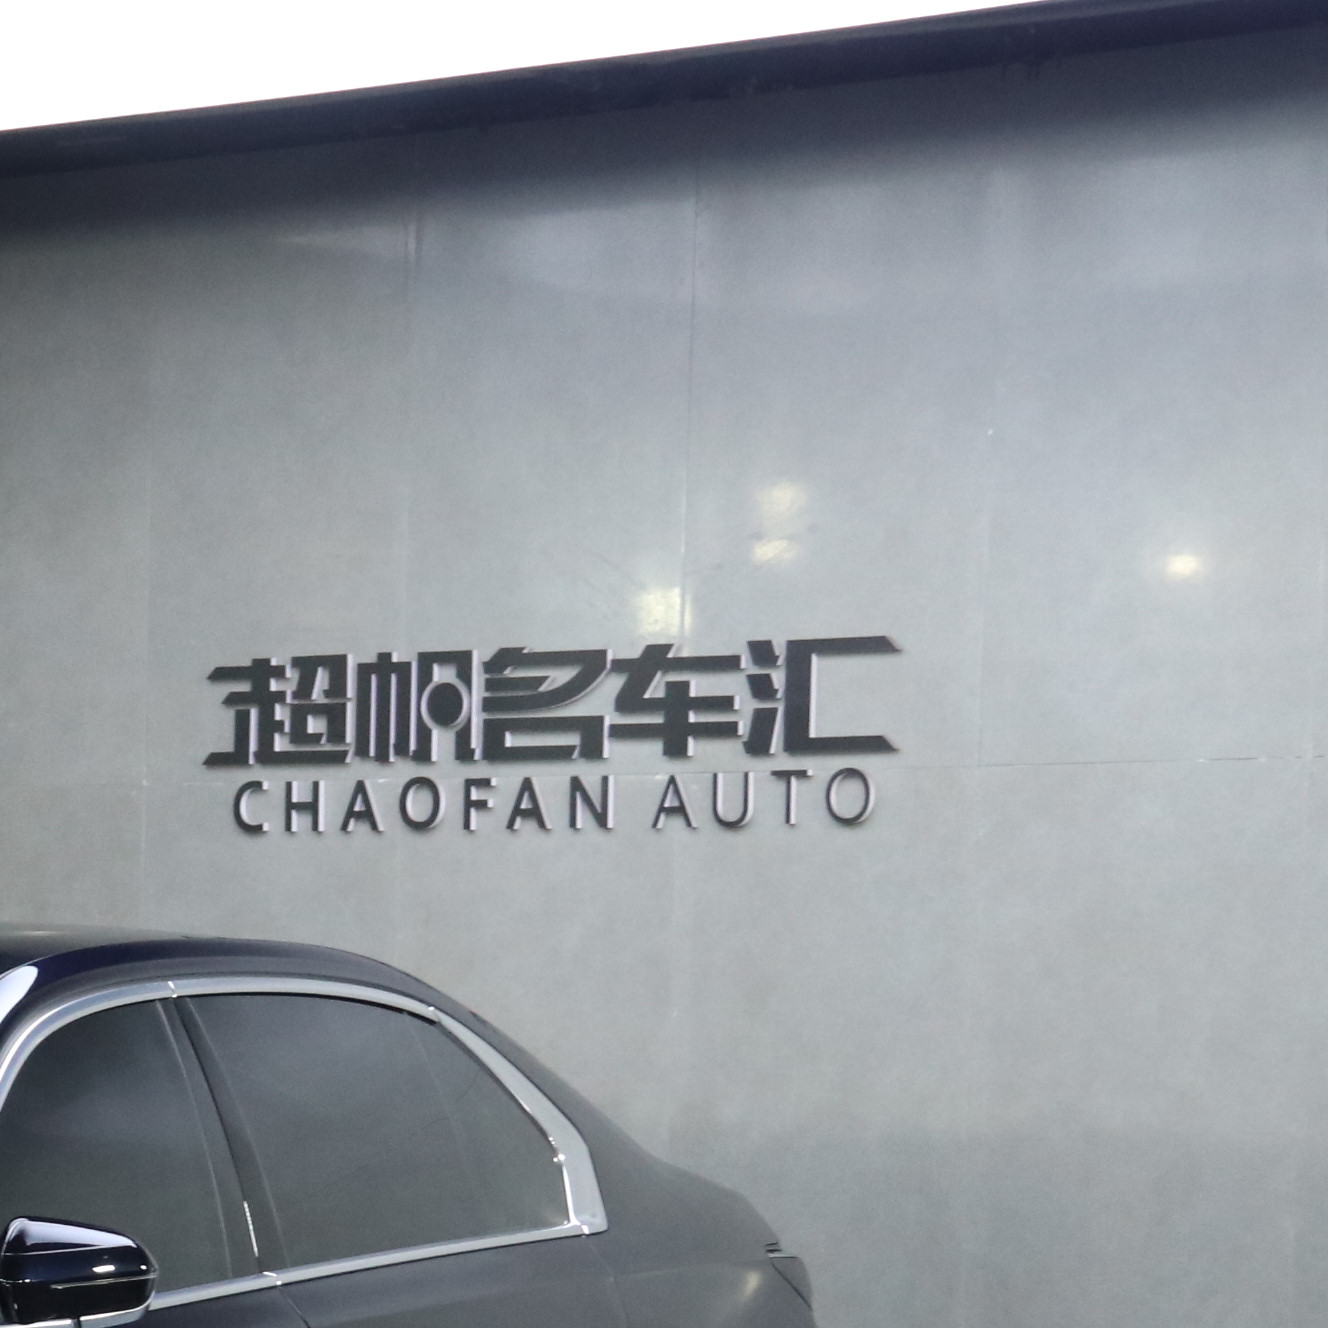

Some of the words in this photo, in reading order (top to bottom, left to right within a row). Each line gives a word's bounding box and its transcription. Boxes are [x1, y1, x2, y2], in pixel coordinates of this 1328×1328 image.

[203, 635, 903, 767] 超帆名车汇
[233, 774, 614, 834] CHAOFAN
[651, 767, 877, 830] AUTO
